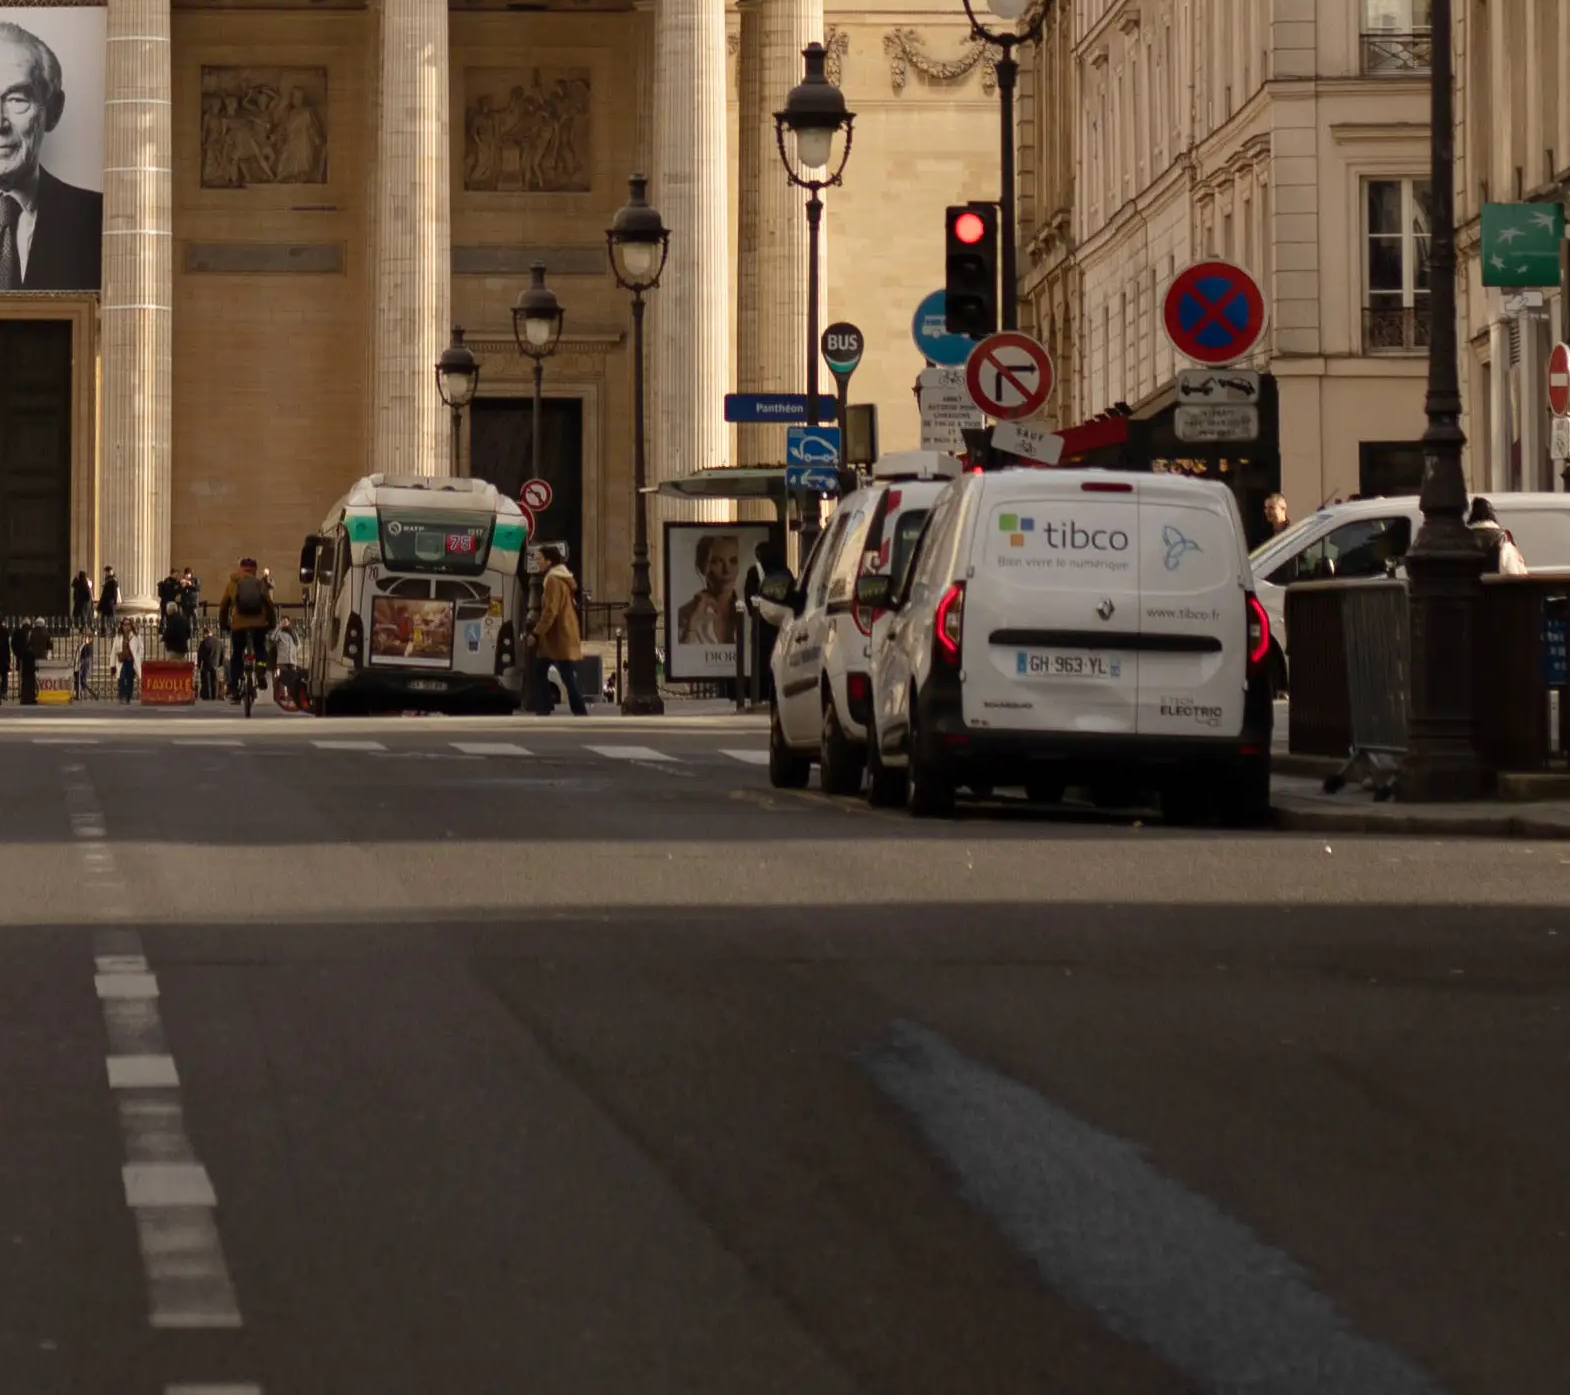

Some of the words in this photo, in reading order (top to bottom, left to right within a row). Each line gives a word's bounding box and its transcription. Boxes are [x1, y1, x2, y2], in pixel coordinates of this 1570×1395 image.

[827, 333, 858, 351] BUS
[756, 401, 804, 414] Panthéon
[1015, 426, 1045, 442] SAUF
[450, 534, 471, 552] 75
[1043, 520, 1128, 552] tibco
[998, 554, 1023, 567] Bien
[1025, 555, 1053, 567] vivre
[1056, 555, 1066, 568] le
[1070, 558, 1129, 571] numérique
[1146, 607, 1221, 622] www.tibco.fr
[146, 676, 192, 693] FAYOLLE
[1160, 705, 1222, 717] ELECTRIC
